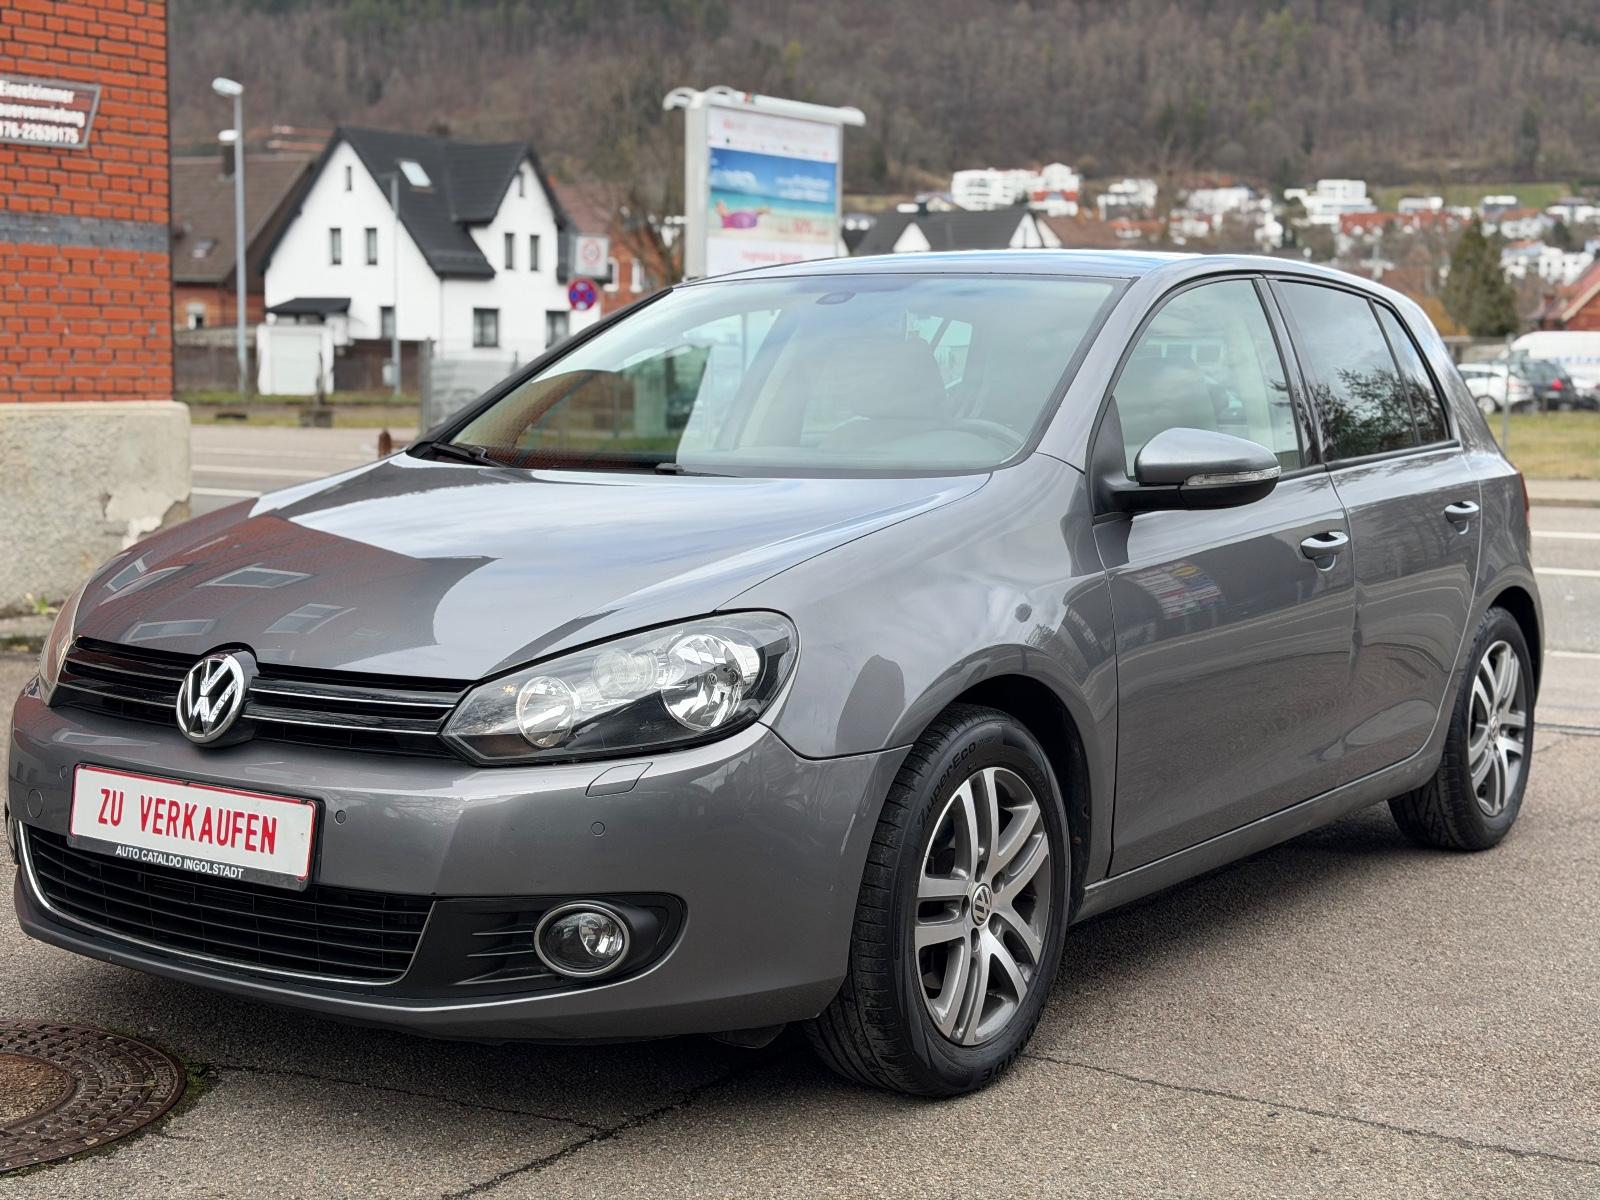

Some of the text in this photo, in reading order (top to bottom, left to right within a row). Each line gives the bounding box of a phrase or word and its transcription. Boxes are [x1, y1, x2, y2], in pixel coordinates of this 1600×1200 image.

[98, 788, 277, 855] ZU VERKAUFEN
[115, 845, 244, 879] AUTO CATALDO INGOLSTADT
